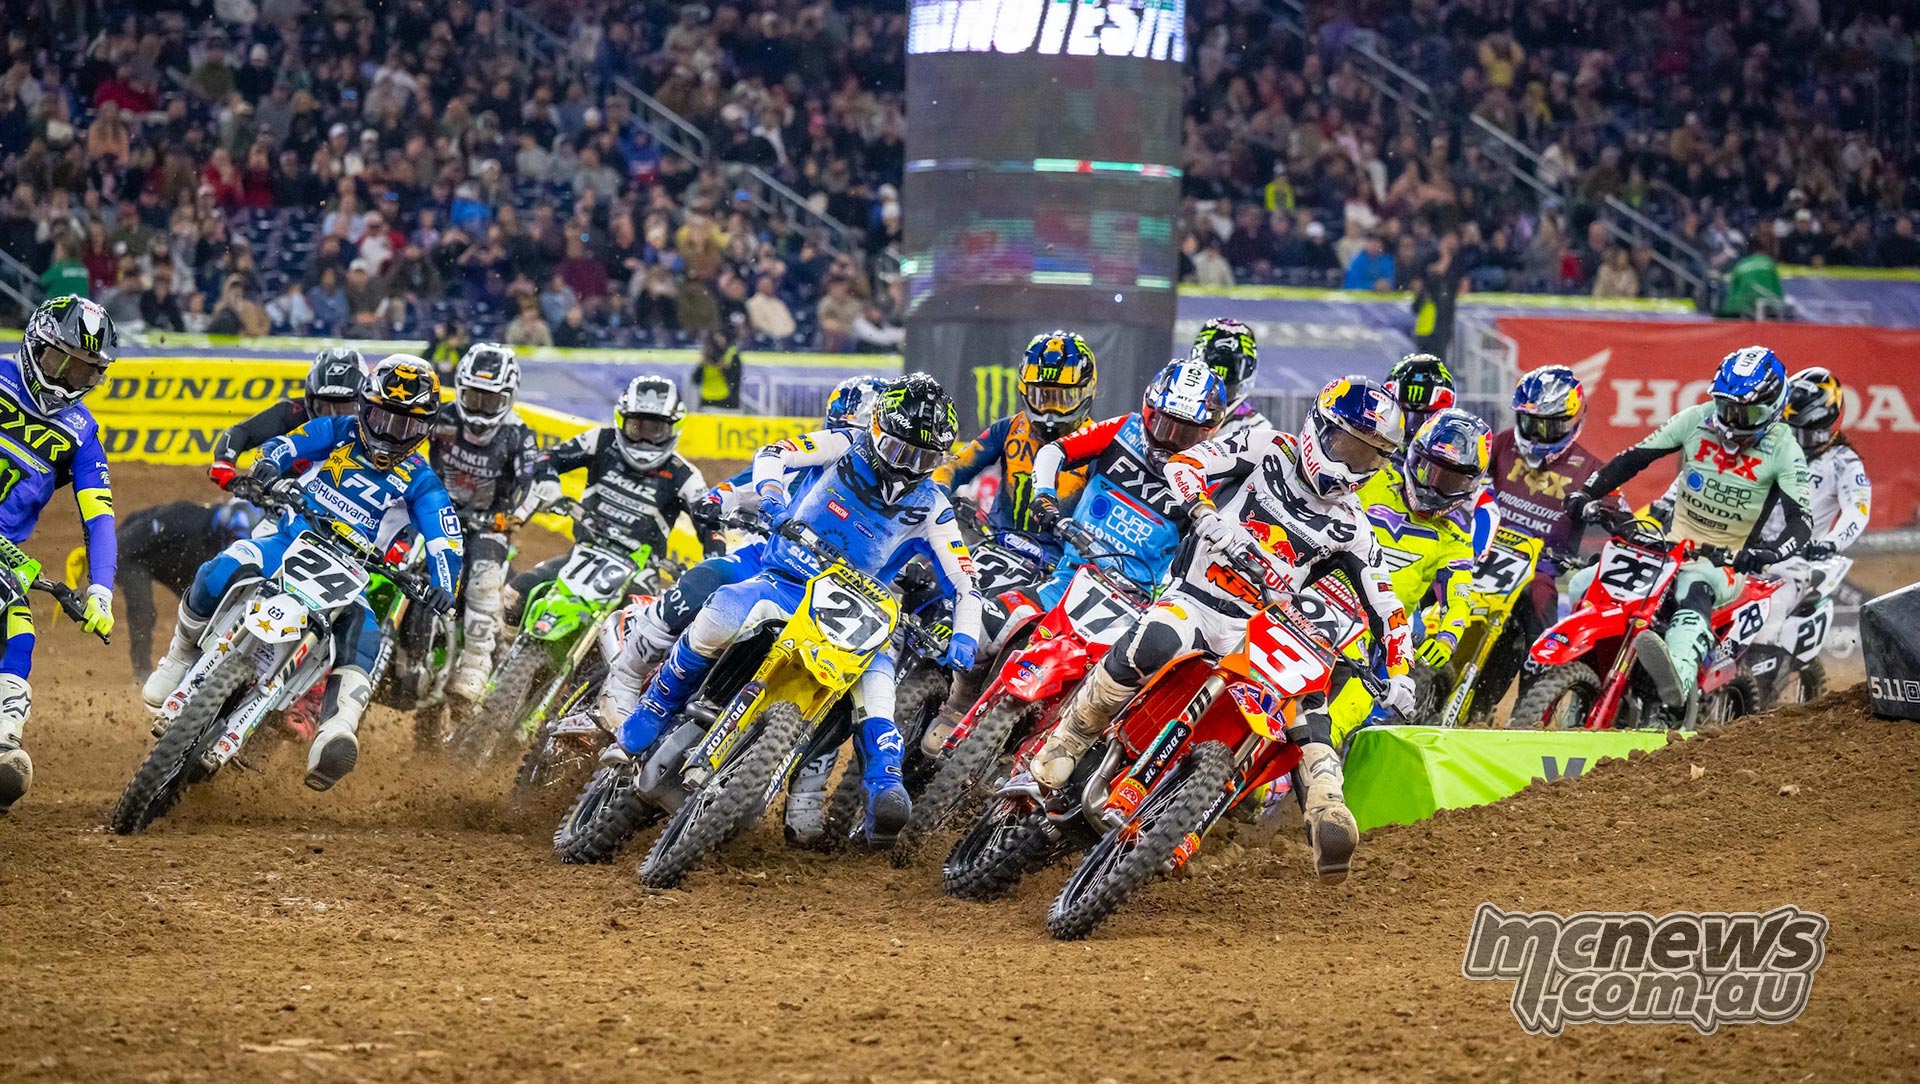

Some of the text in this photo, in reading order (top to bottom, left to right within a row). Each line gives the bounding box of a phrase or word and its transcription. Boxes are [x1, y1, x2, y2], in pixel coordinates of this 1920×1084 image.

[103, 429, 224, 454] DUN
[1694, 438, 1763, 482] FOX
[342, 473, 395, 511] FLY
[602, 470, 657, 502] SKILLZ
[1106, 455, 1183, 515] FXR
[1704, 487, 1749, 511] LOCK
[1706, 478, 1752, 500] QUAD
[317, 483, 377, 530] Husqvarna
[1111, 505, 1153, 537] QUAD
[1497, 490, 1564, 521] PROGRESSIVE
[1499, 507, 1553, 534] SUZUKI
[1681, 490, 1744, 521] HONDA
[1083, 521, 1136, 556] HONDA
[1106, 515, 1147, 547] LOCK
[285, 548, 360, 604] 24
[566, 551, 627, 595] 719
[815, 592, 883, 647] 21
[1068, 586, 1128, 635] 17
[1738, 603, 1764, 641] 28
[1798, 612, 1828, 653] 27
[1249, 626, 1326, 694] 3
[1870, 676, 1903, 701] 5.11
[238, 694, 265, 726] DUNLO
